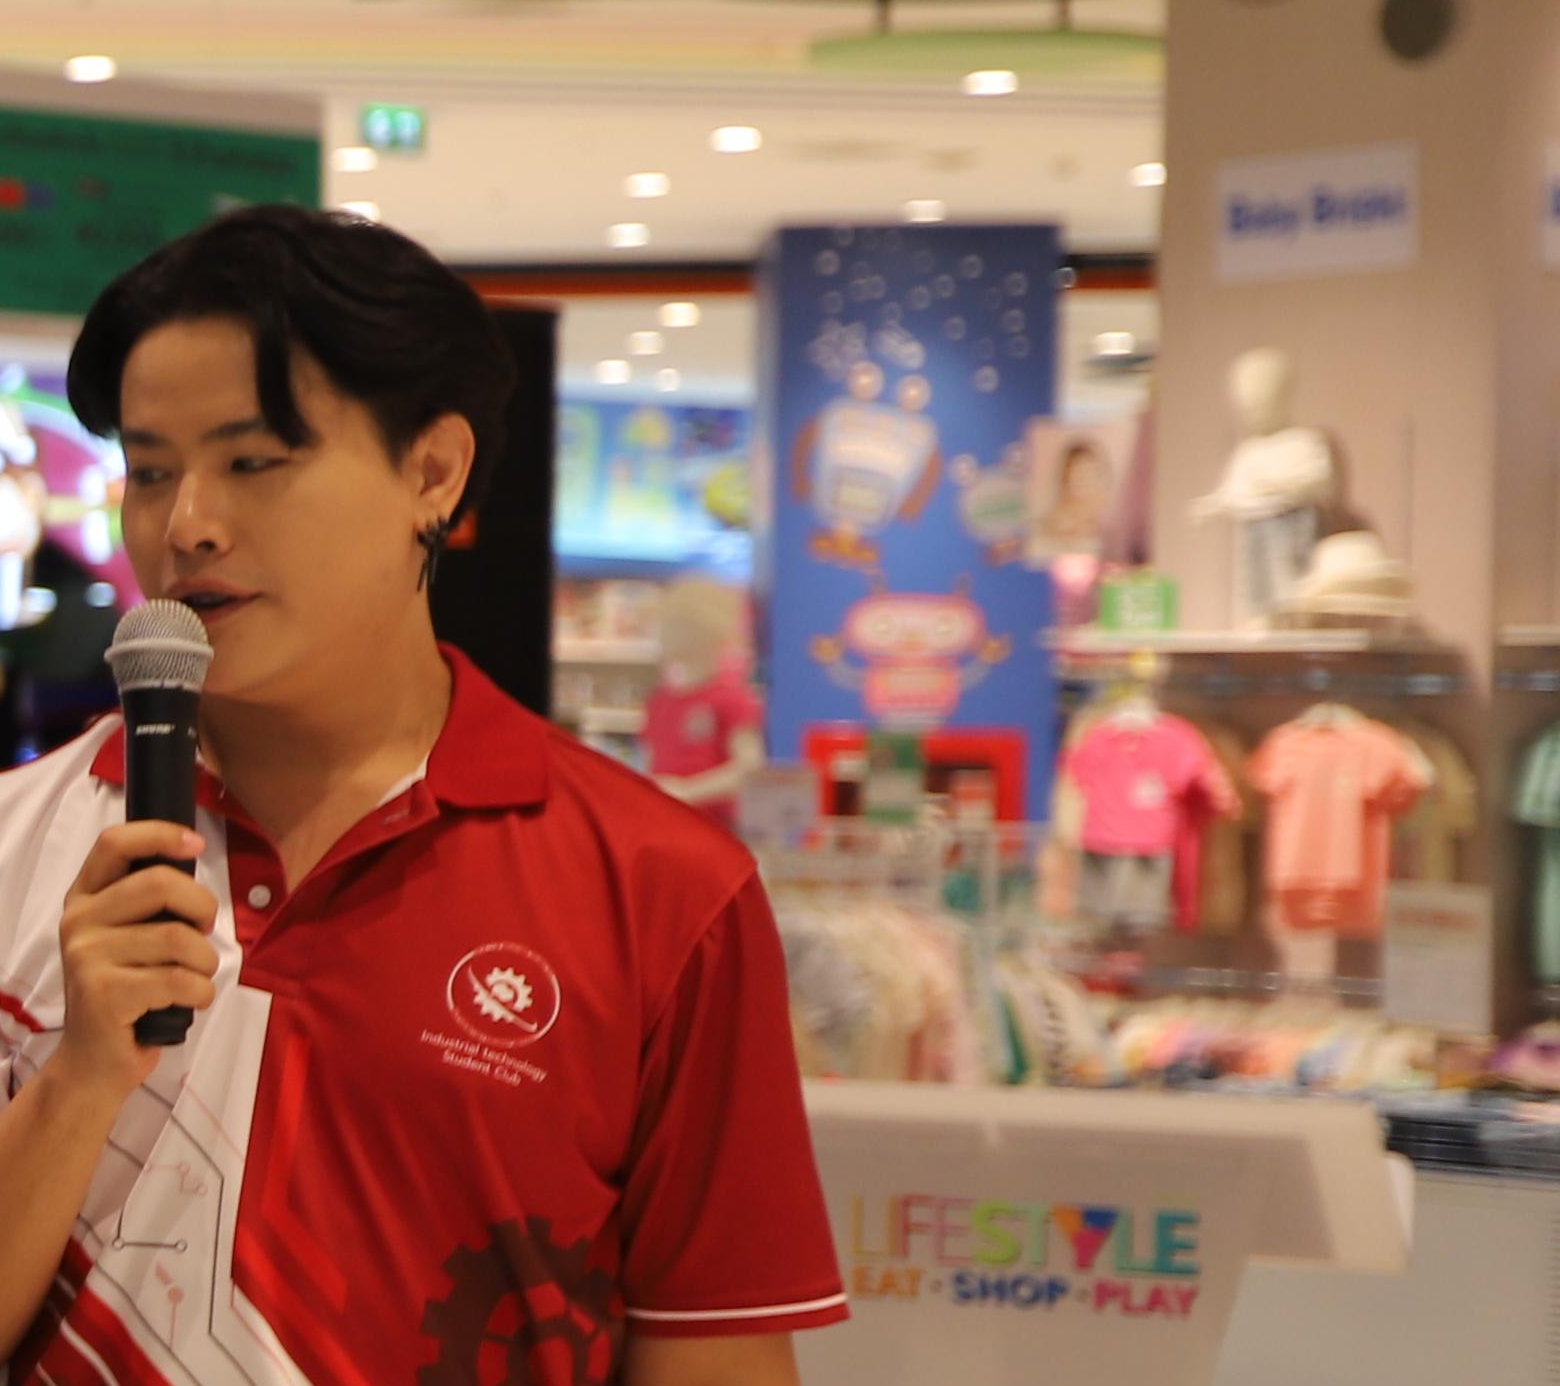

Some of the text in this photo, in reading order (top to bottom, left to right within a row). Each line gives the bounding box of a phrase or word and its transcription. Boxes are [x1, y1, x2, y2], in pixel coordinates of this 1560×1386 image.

[420, 1028, 481, 1054] Industrial
[443, 1048, 492, 1077] Student
[850, 1192, 1201, 1278] LIFESTYLE
[950, 1271, 1069, 1311] SHOP
[1093, 1279, 1200, 1321] PLAY
